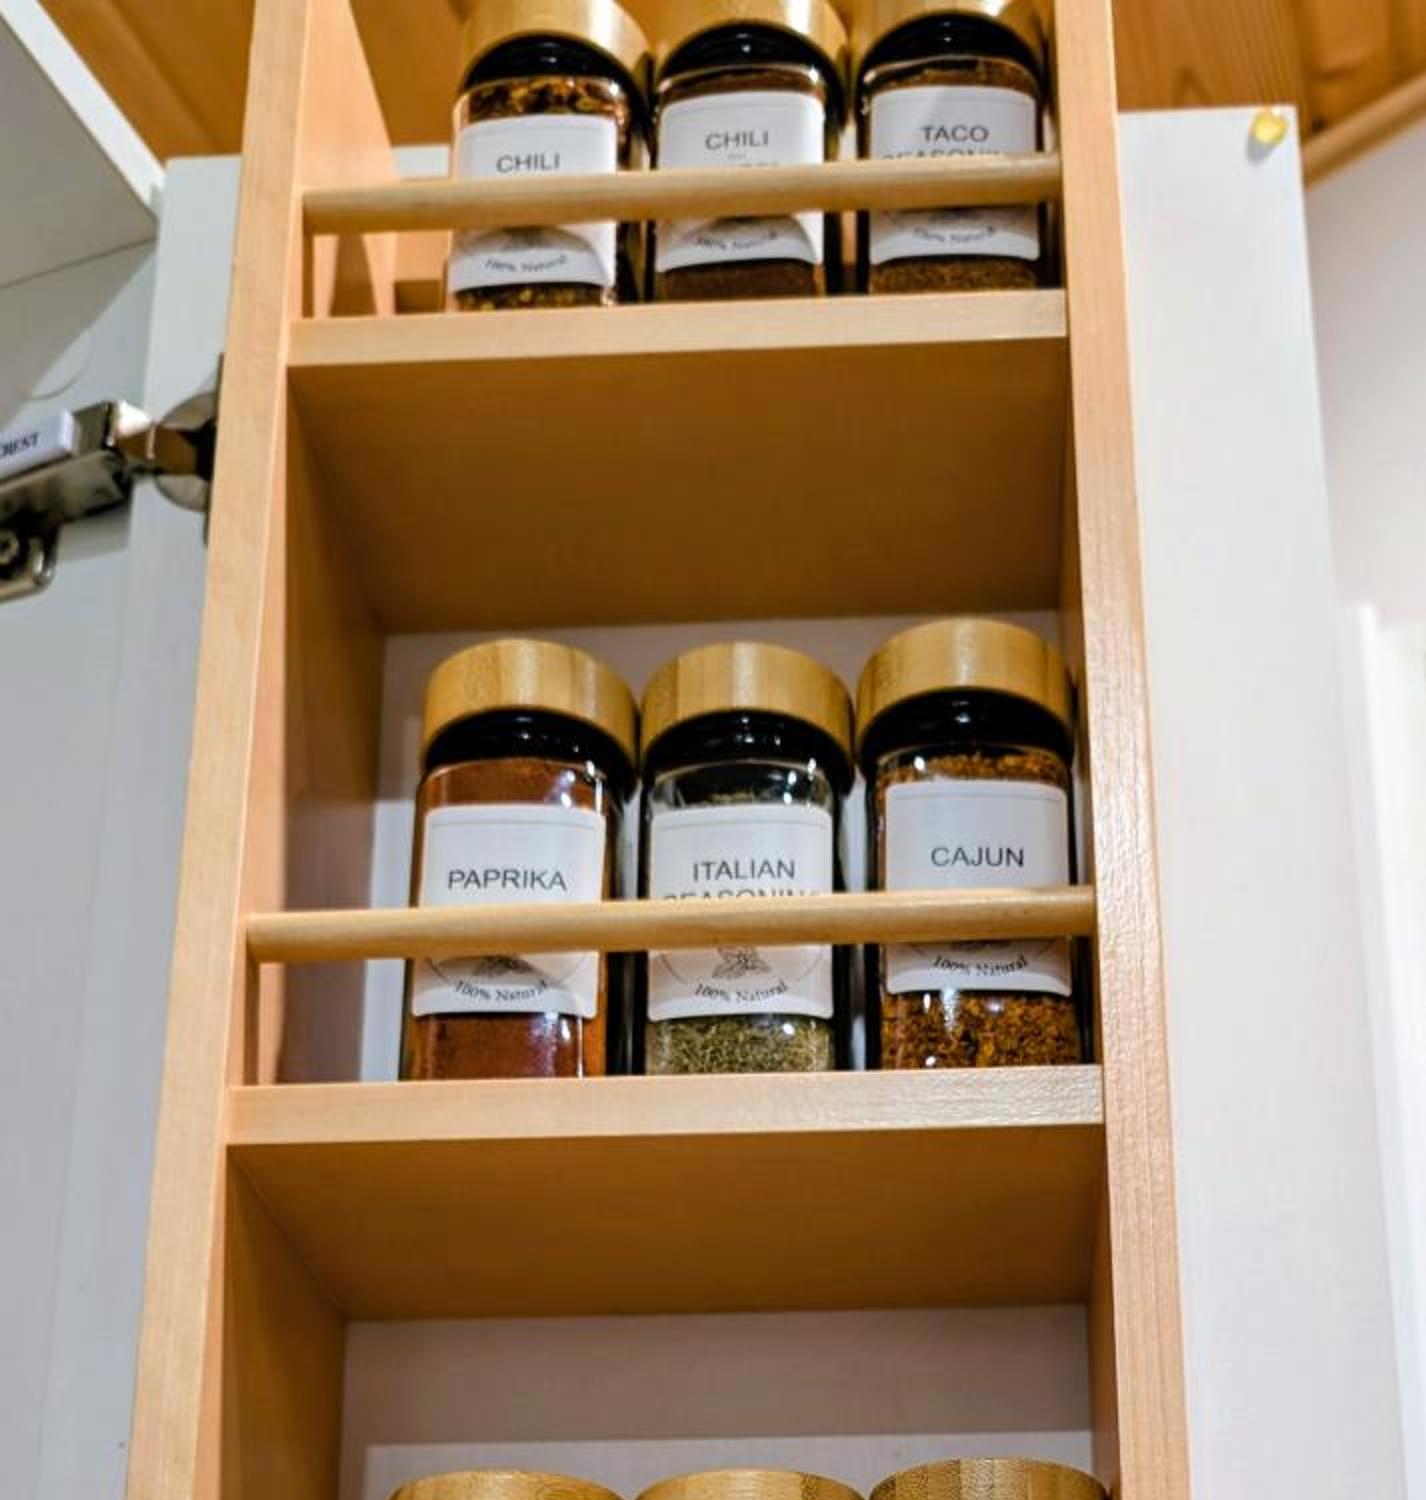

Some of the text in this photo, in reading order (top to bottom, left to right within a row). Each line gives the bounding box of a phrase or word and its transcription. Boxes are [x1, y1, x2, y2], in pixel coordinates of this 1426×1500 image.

[705, 131, 769, 150] CHILI
[922, 125, 989, 142] TACO
[496, 153, 560, 173] CHILI
[930, 847, 1024, 868] CAJUN
[448, 869, 567, 891] PAPRIKA
[692, 860, 795, 882] ITALIAN
[455, 979, 491, 1001] 100%
[694, 979, 789, 1003] 100% Natural
